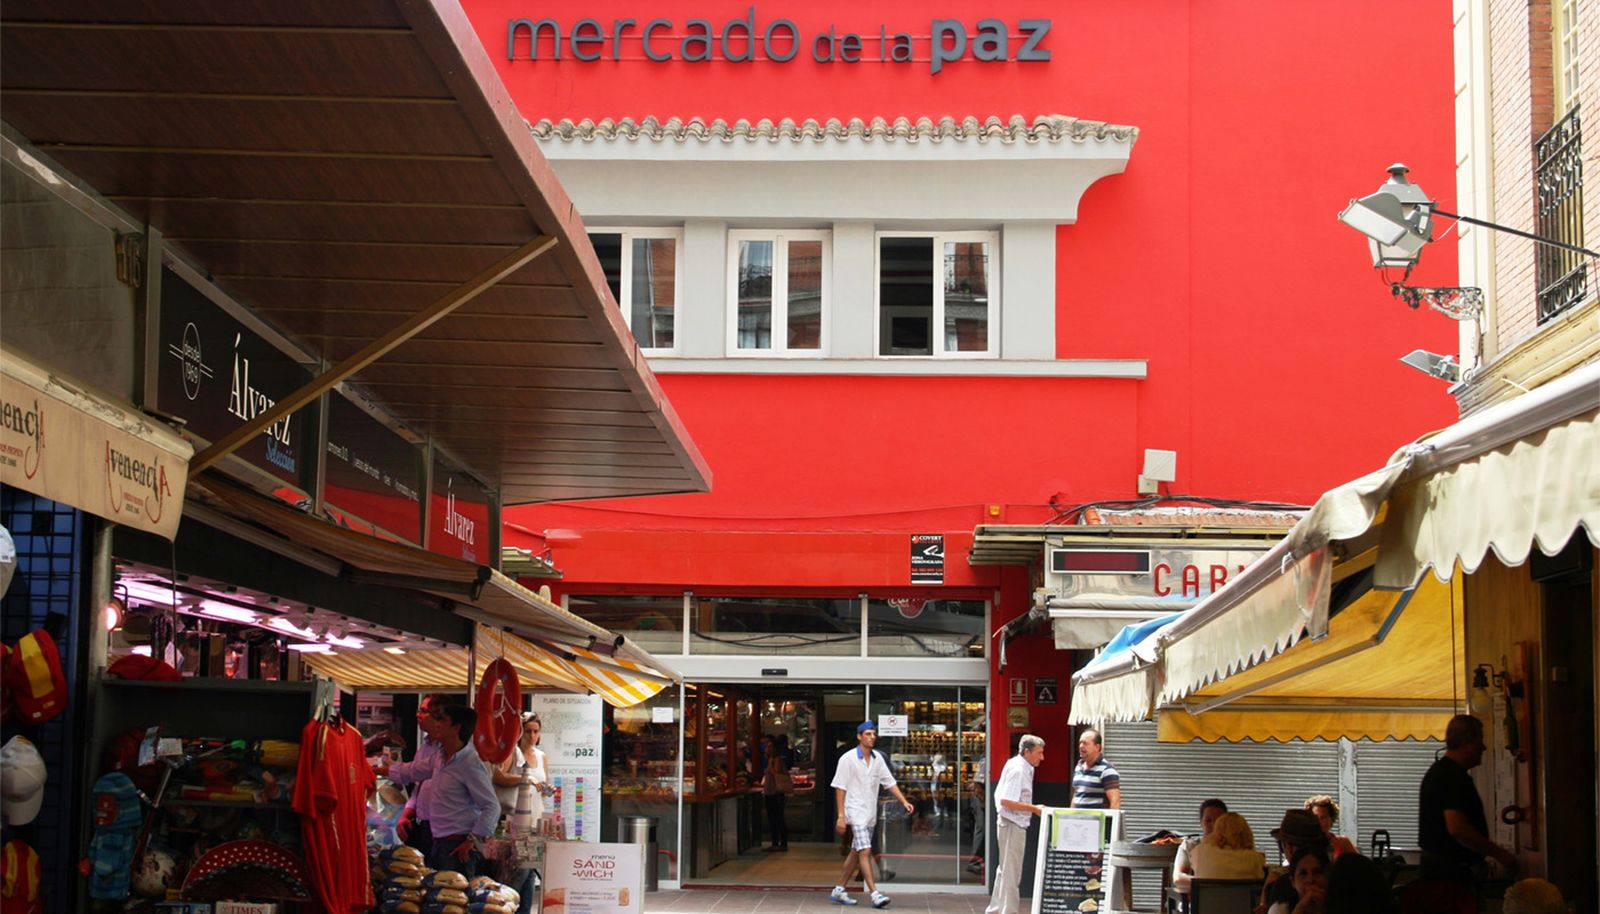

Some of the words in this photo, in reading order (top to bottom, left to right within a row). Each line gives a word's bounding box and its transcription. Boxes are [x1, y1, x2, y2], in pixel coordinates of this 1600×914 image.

[507, 6, 799, 63] mercado
[812, 24, 862, 63] de
[880, 24, 912, 62] la
[930, 18, 1051, 75] paz
[443, 477, 475, 546] Álvarez
[575, 747, 594, 758] paz
